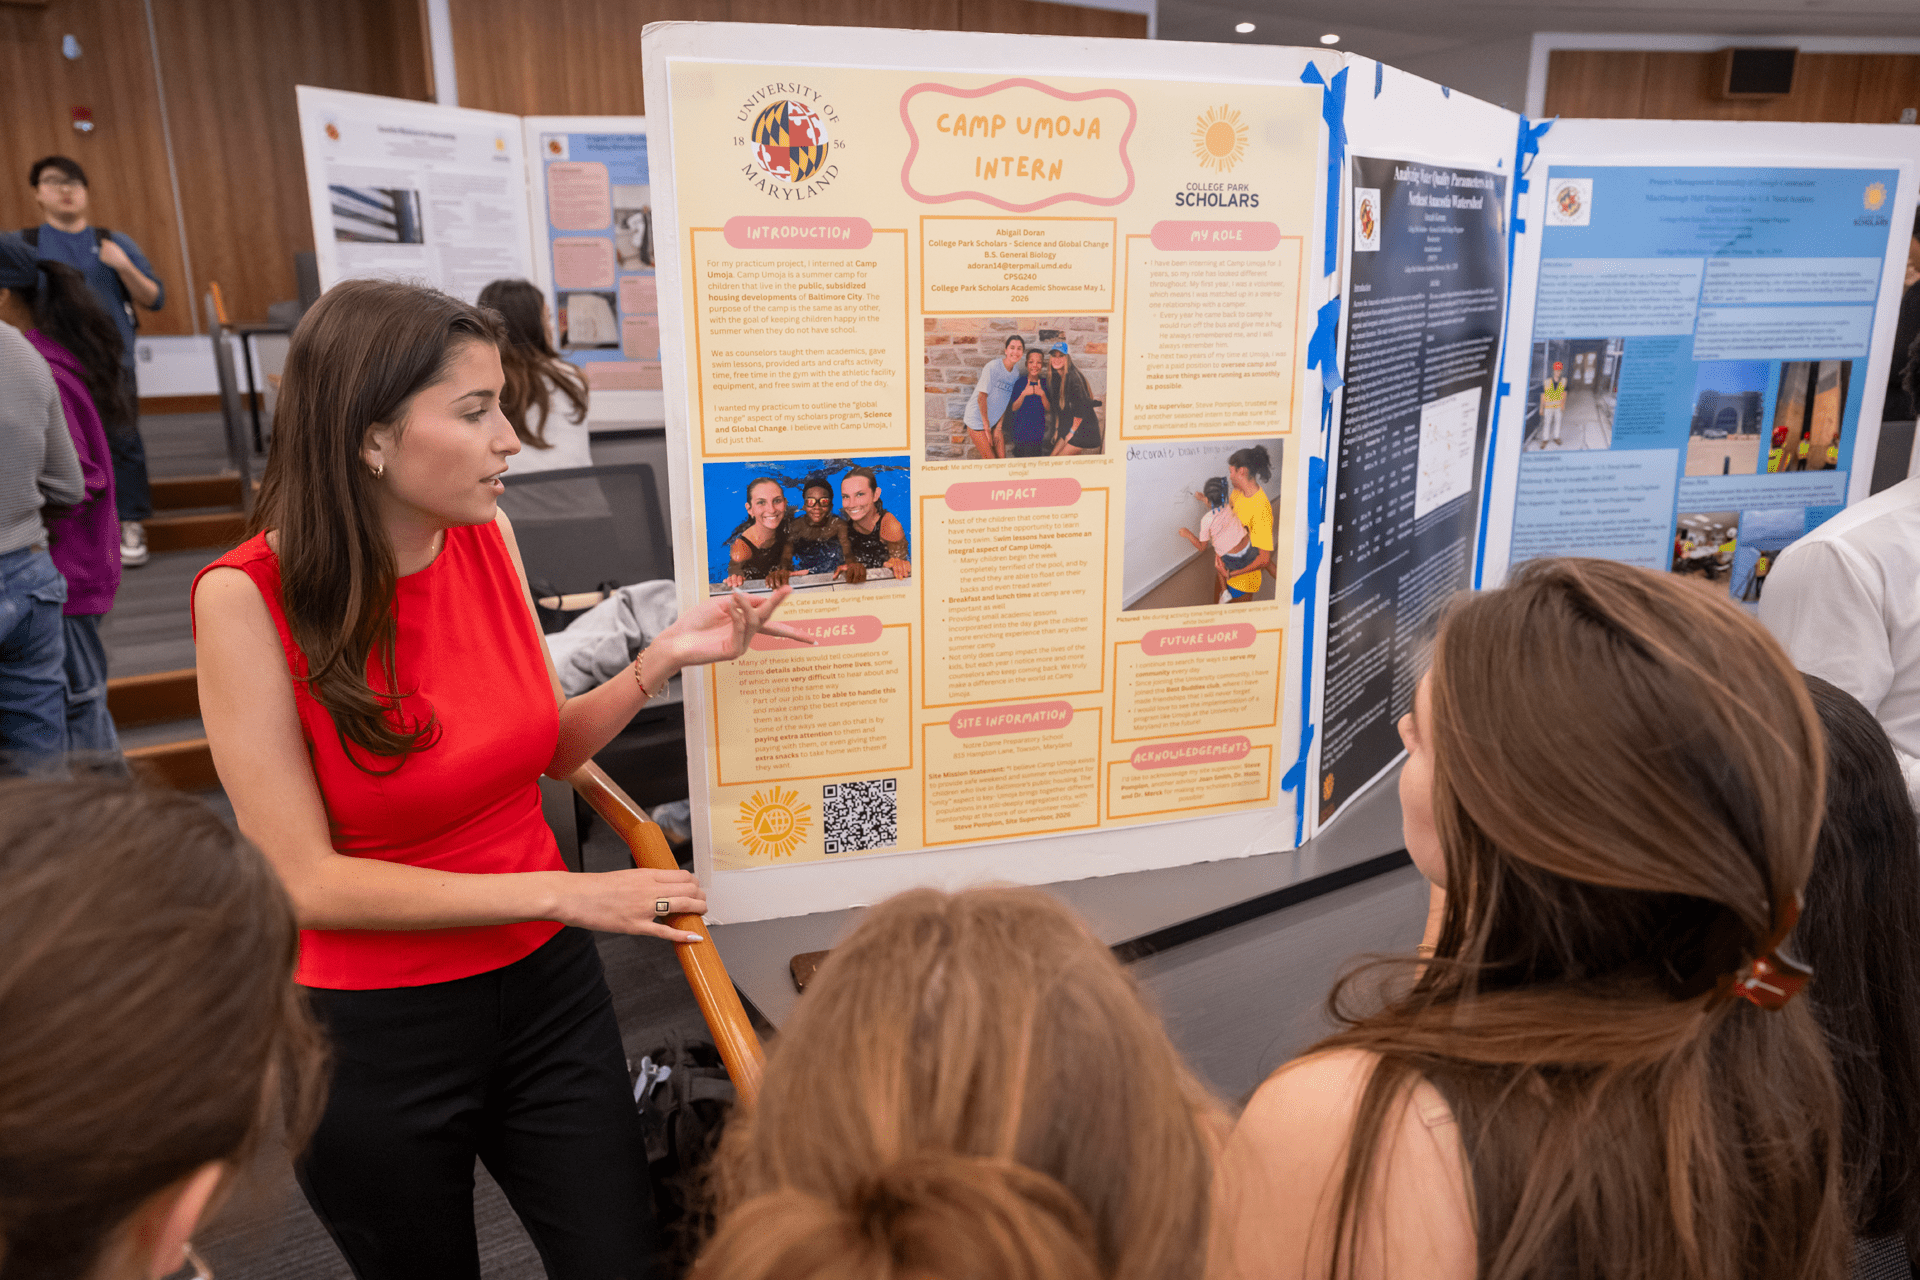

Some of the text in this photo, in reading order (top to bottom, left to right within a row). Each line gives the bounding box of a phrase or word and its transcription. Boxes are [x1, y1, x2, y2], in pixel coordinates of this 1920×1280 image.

[738, 82, 839, 123] UNIVERSITY OF
[936, 113, 1100, 140] CAMP UMOJA
[733, 136, 744, 146] 18
[834, 140, 846, 149] 56
[975, 155, 1062, 182] INTERN
[741, 164, 838, 200] MARYLAND
[1186, 182, 1249, 191] COLLEGE PARK
[1175, 191, 1259, 208] SCHOLARS
[747, 225, 850, 240] INTRODUCTION
[996, 228, 1045, 238] Abigail Doran
[1190, 229, 1242, 242] MY ROLE
[928, 239, 956, 248] College
[958, 239, 974, 247] Park
[976, 239, 1008, 247] Scholars
[1013, 239, 1042, 247] Science
[1083, 240, 1109, 249] Change
[984, 250, 997, 258] B.S.
[1029, 251, 1056, 260] Biology
[706, 259, 719, 267] For
[735, 260, 775, 268] practicum
[776, 260, 806, 268] project,
[808, 259, 810, 267] I
[855, 259, 877, 268] Camp
[967, 262, 1072, 270] adoran14@terpmail.umd.edu
[707, 270, 734, 280] Umoja.
[736, 271, 760, 279] Camp
[761, 271, 786, 279] Umoja
[856, 270, 867, 278] for
[798, 281, 824, 291] public,
[826, 281, 866, 289] subsidized
[931, 284, 958, 293] College
[1083, 284, 1098, 292] May
[708, 293, 740, 302] housing
[741, 293, 797, 302] developments
[1010, 294, 1029, 302] 2026
[708, 306, 741, 314] purpose
[742, 304, 751, 312] of
[753, 304, 766, 312] the
[767, 305, 789, 313] camp
[709, 316, 726, 324] with
[742, 316, 759, 325] goal
[760, 315, 769, 323] of
[770, 315, 800, 324] keeping
[833, 315, 857, 324] happy
[867, 314, 879, 322] the
[765, 327, 783, 335] they
[784, 326, 795, 334] do
[991, 487, 1036, 501] IMPACT
[1160, 629, 1238, 647] FUTURE WORK
[956, 709, 1066, 729] SITE INFORMATION
[1133, 742, 1248, 764] ACKNOWLEDGEMENTS
